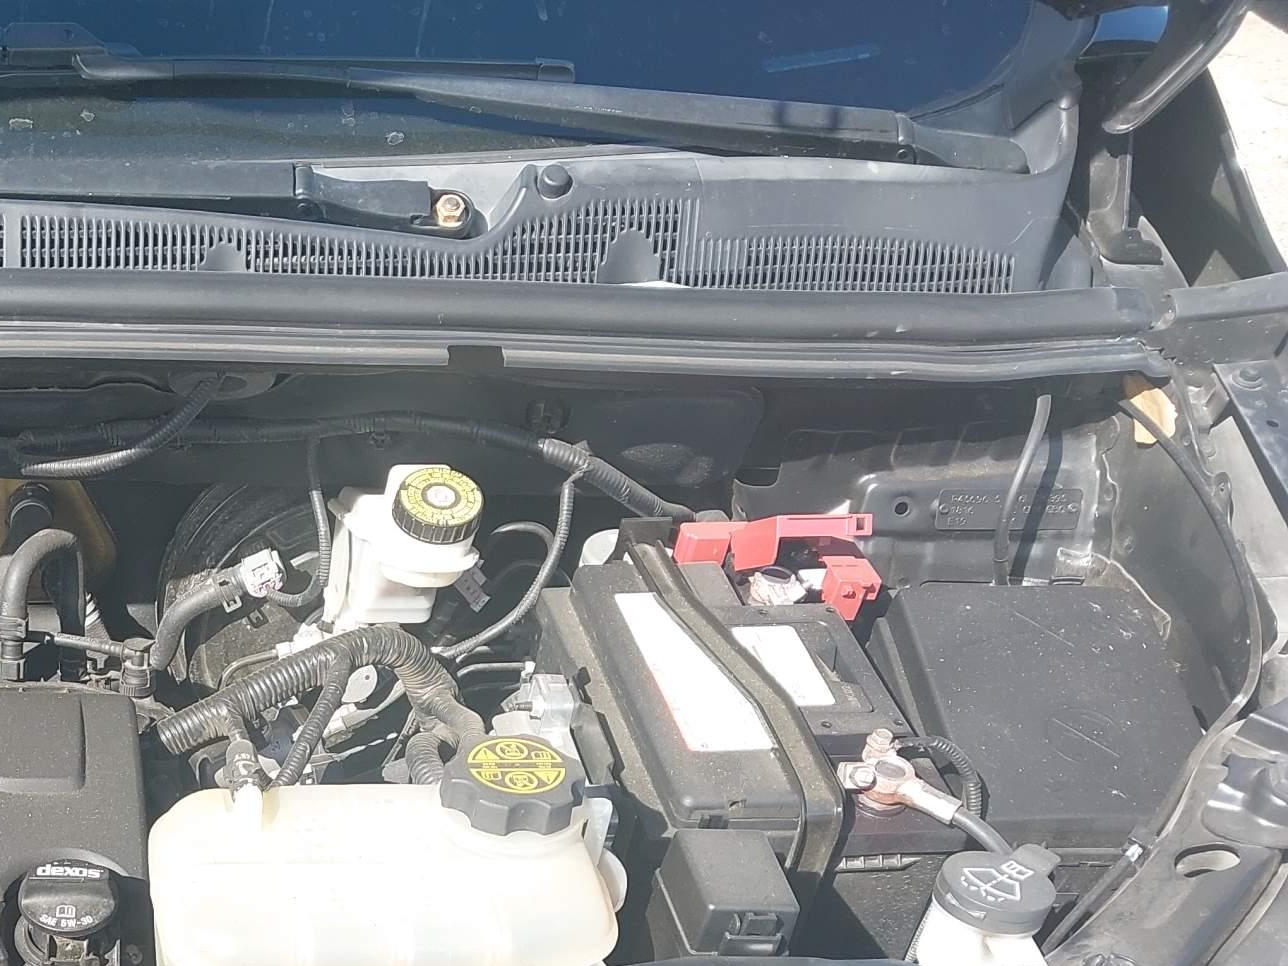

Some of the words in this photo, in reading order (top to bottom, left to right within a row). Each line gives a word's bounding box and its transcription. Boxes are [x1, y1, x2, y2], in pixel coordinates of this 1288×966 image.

[36, 863, 101, 878] dexos
[39, 914, 58, 927] SAE
[60, 915, 94, 928] 5W-30
